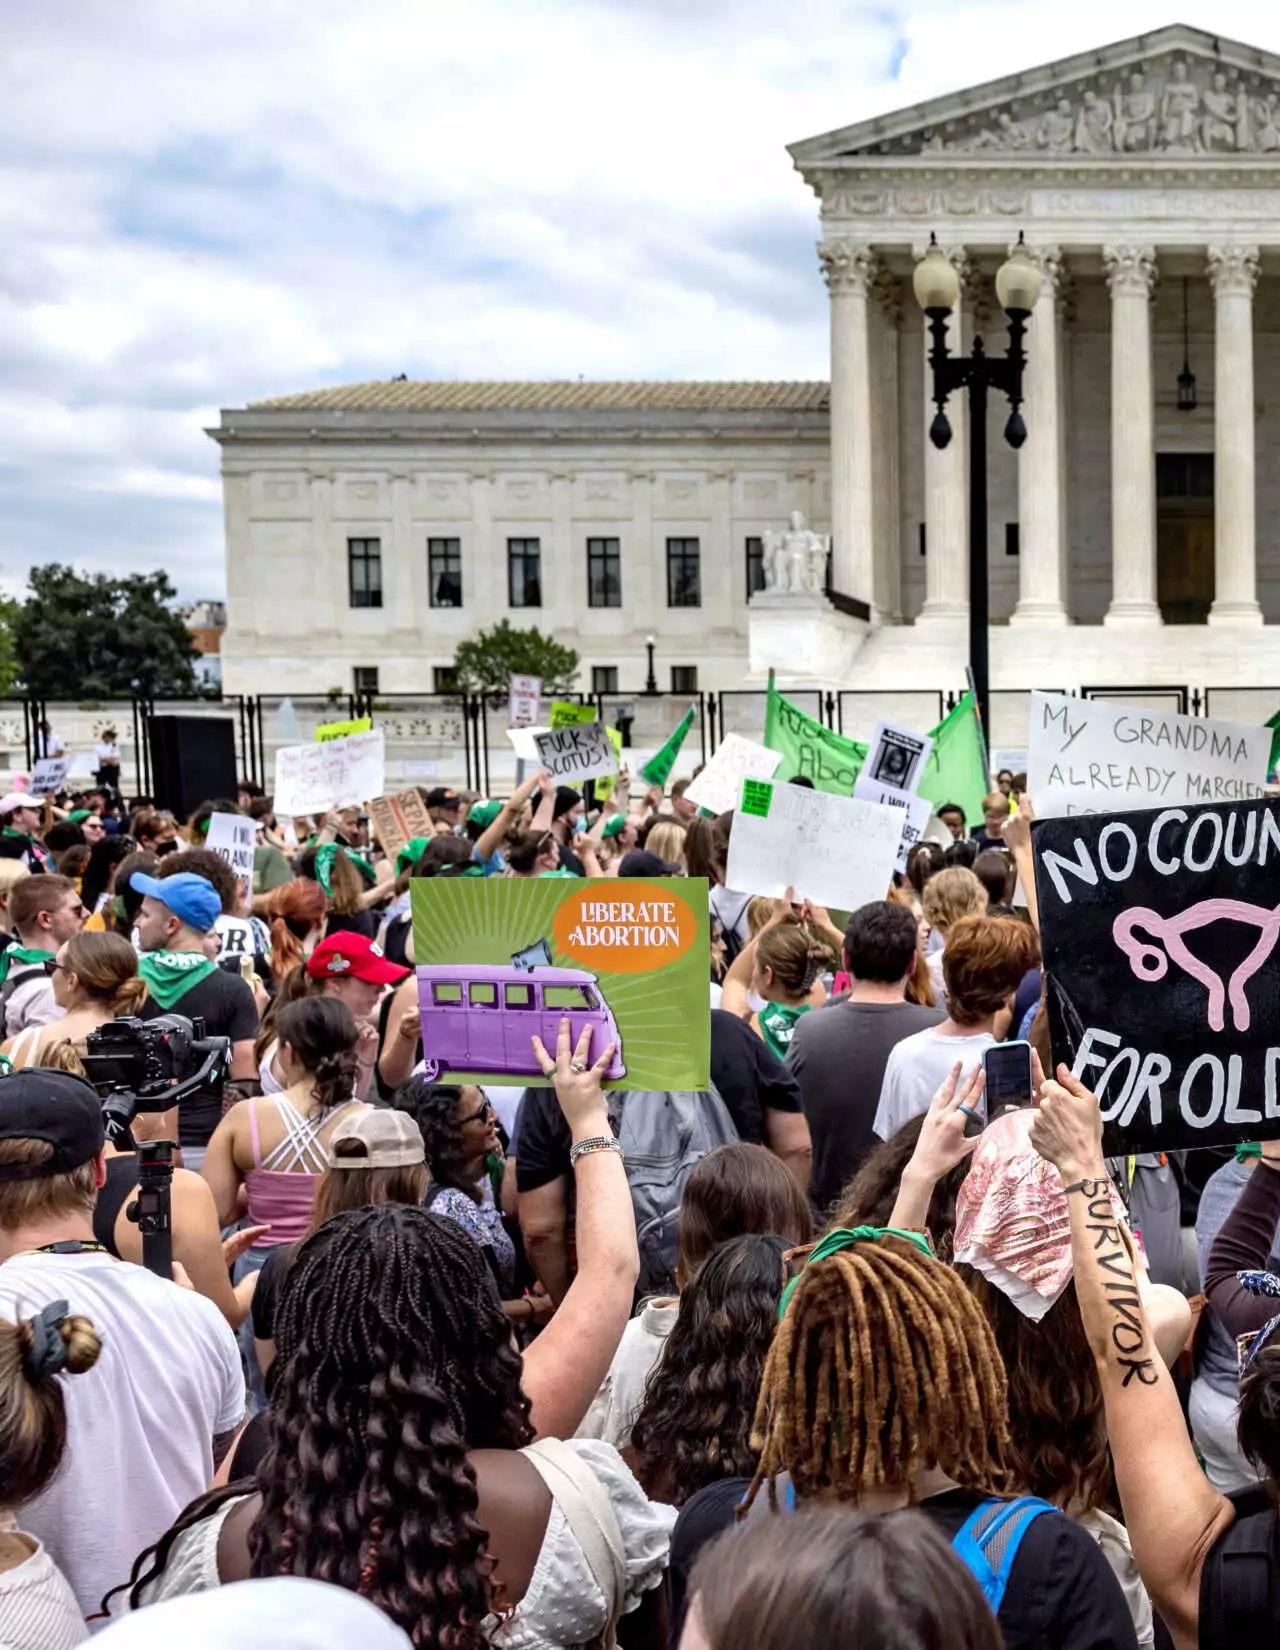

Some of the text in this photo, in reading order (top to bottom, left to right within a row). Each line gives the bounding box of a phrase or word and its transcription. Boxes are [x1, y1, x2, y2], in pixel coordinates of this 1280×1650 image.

[537, 730, 587, 756] FUCK
[1044, 703, 1248, 763] My GRANDMA
[1049, 763, 1176, 797] ALREADY
[1041, 821, 1138, 904] NO
[568, 925, 680, 947] ABORTION
[581, 902, 676, 923] LIBERATE
[1072, 1028, 1172, 1126] FOR
[1081, 1178, 1159, 1387] SURVIVOR
